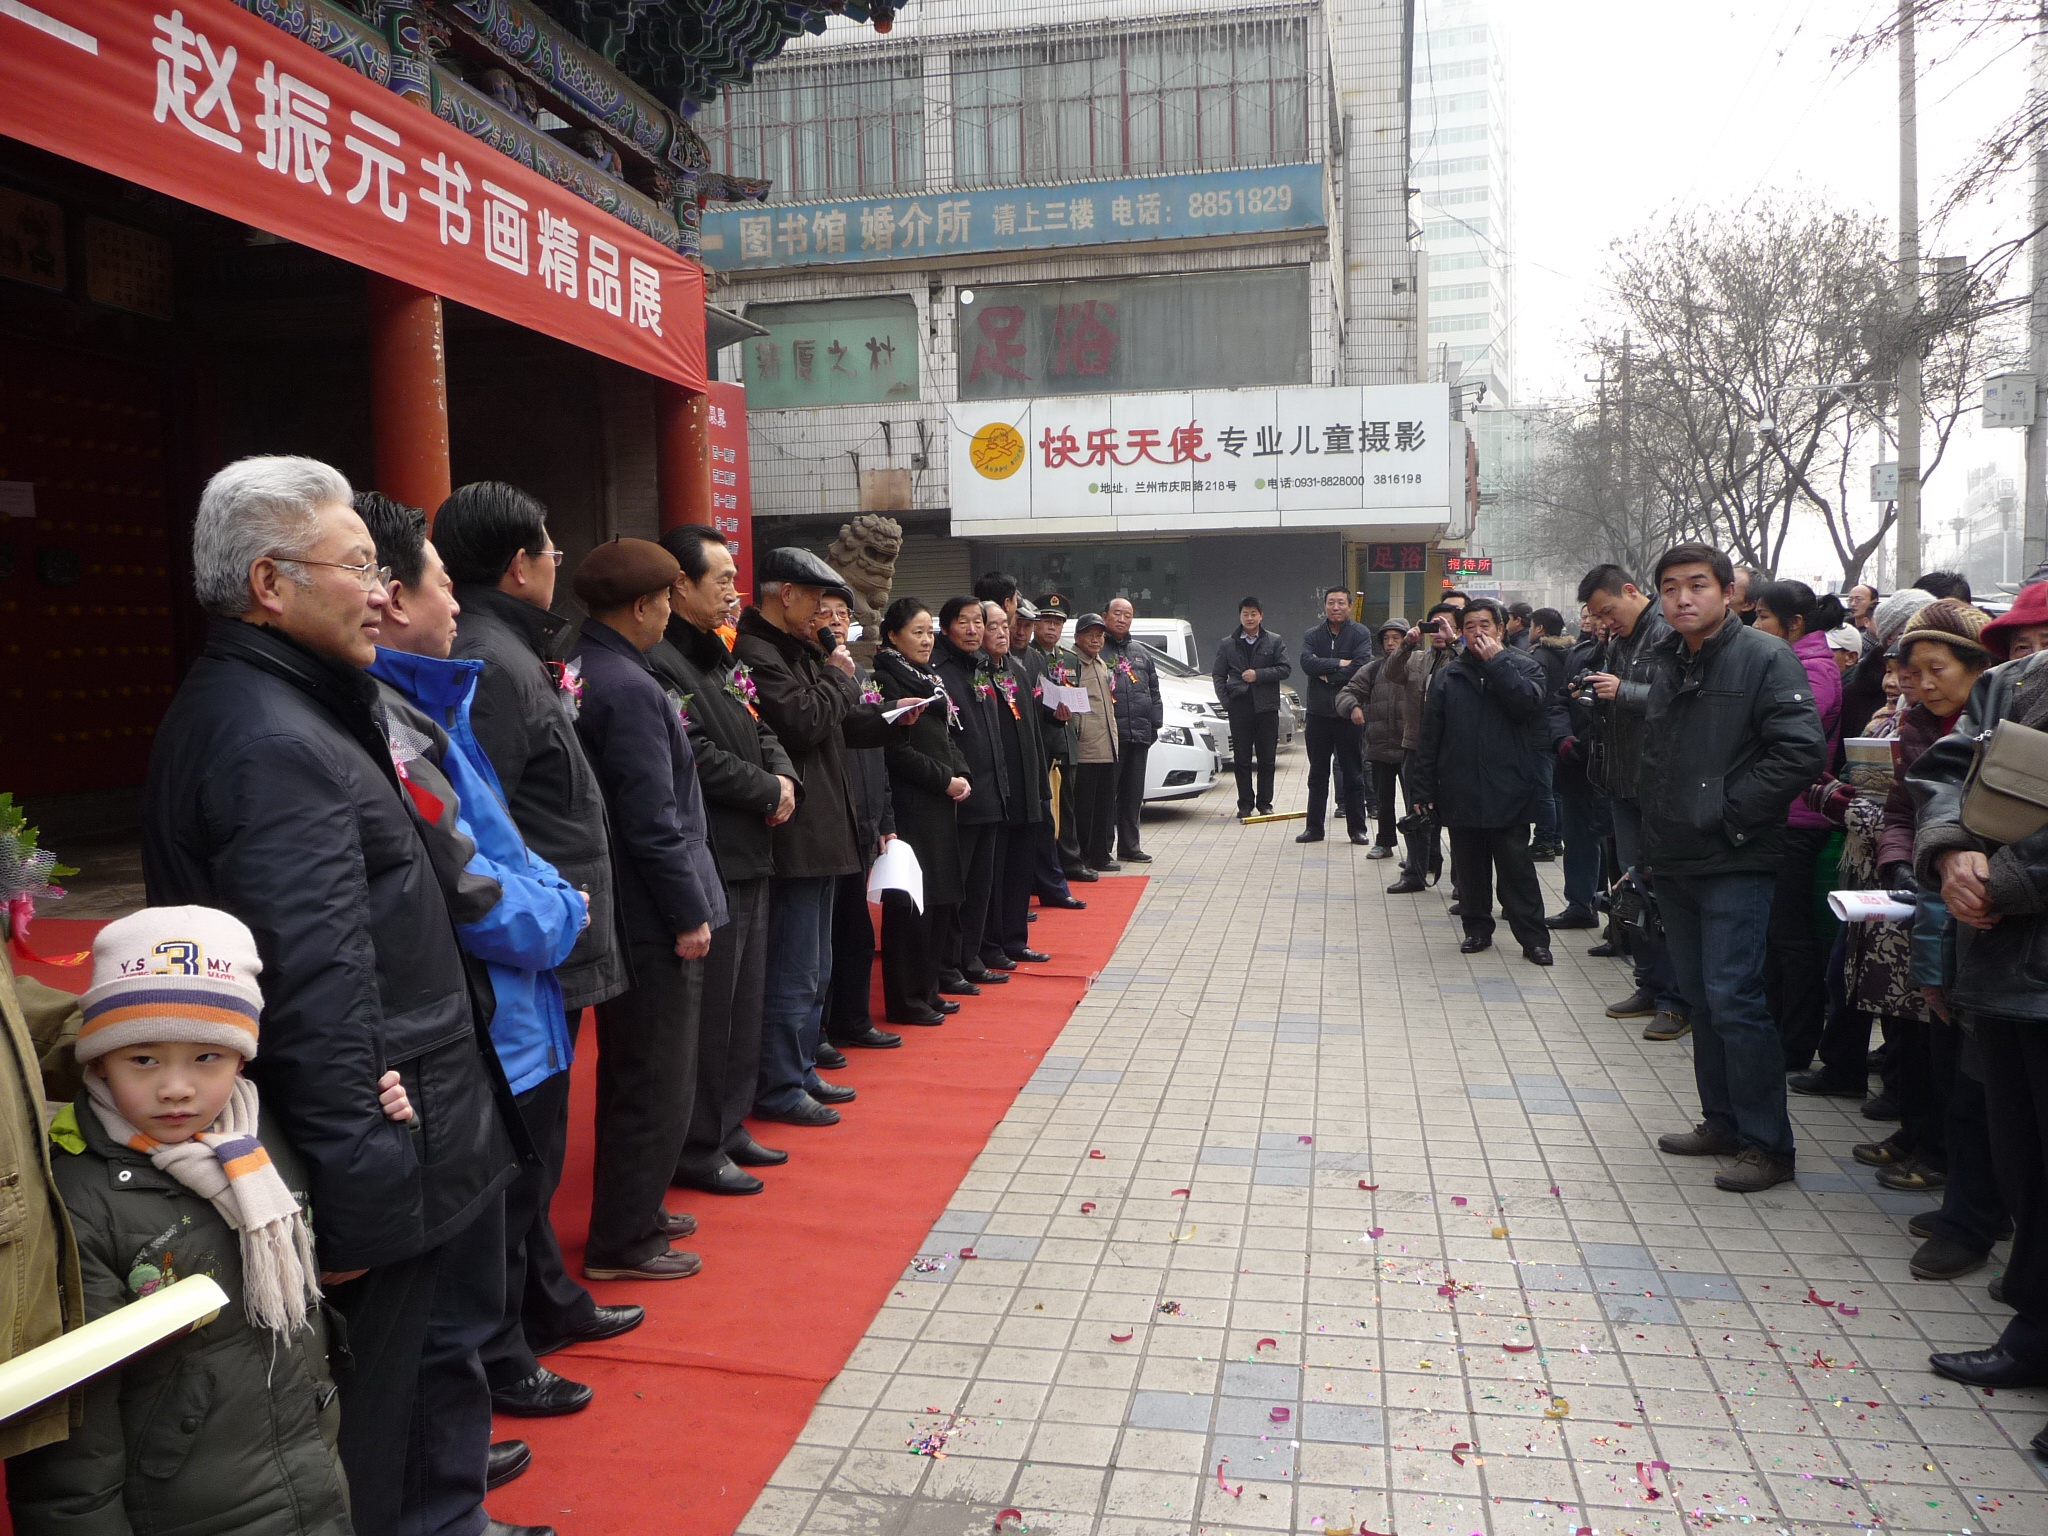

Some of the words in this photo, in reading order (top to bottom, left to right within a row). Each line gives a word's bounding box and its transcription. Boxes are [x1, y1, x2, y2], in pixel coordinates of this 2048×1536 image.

[152, 9, 663, 337] 赵振元书画精品展
[740, 208, 847, 260] 图书馆
[859, 200, 972, 250] 婚介所
[992, 198, 1095, 235] 请上三楼
[968, 300, 1121, 383] 足浴
[1038, 419, 1212, 469] 快乐天使
[1217, 420, 1426, 458] 专业儿童摄影
[1373, 474, 1422, 486] 3816198
[1373, 545, 1423, 569] 足浴
[1447, 558, 1491, 571] 招待所
[152, 938, 204, 976] 3
